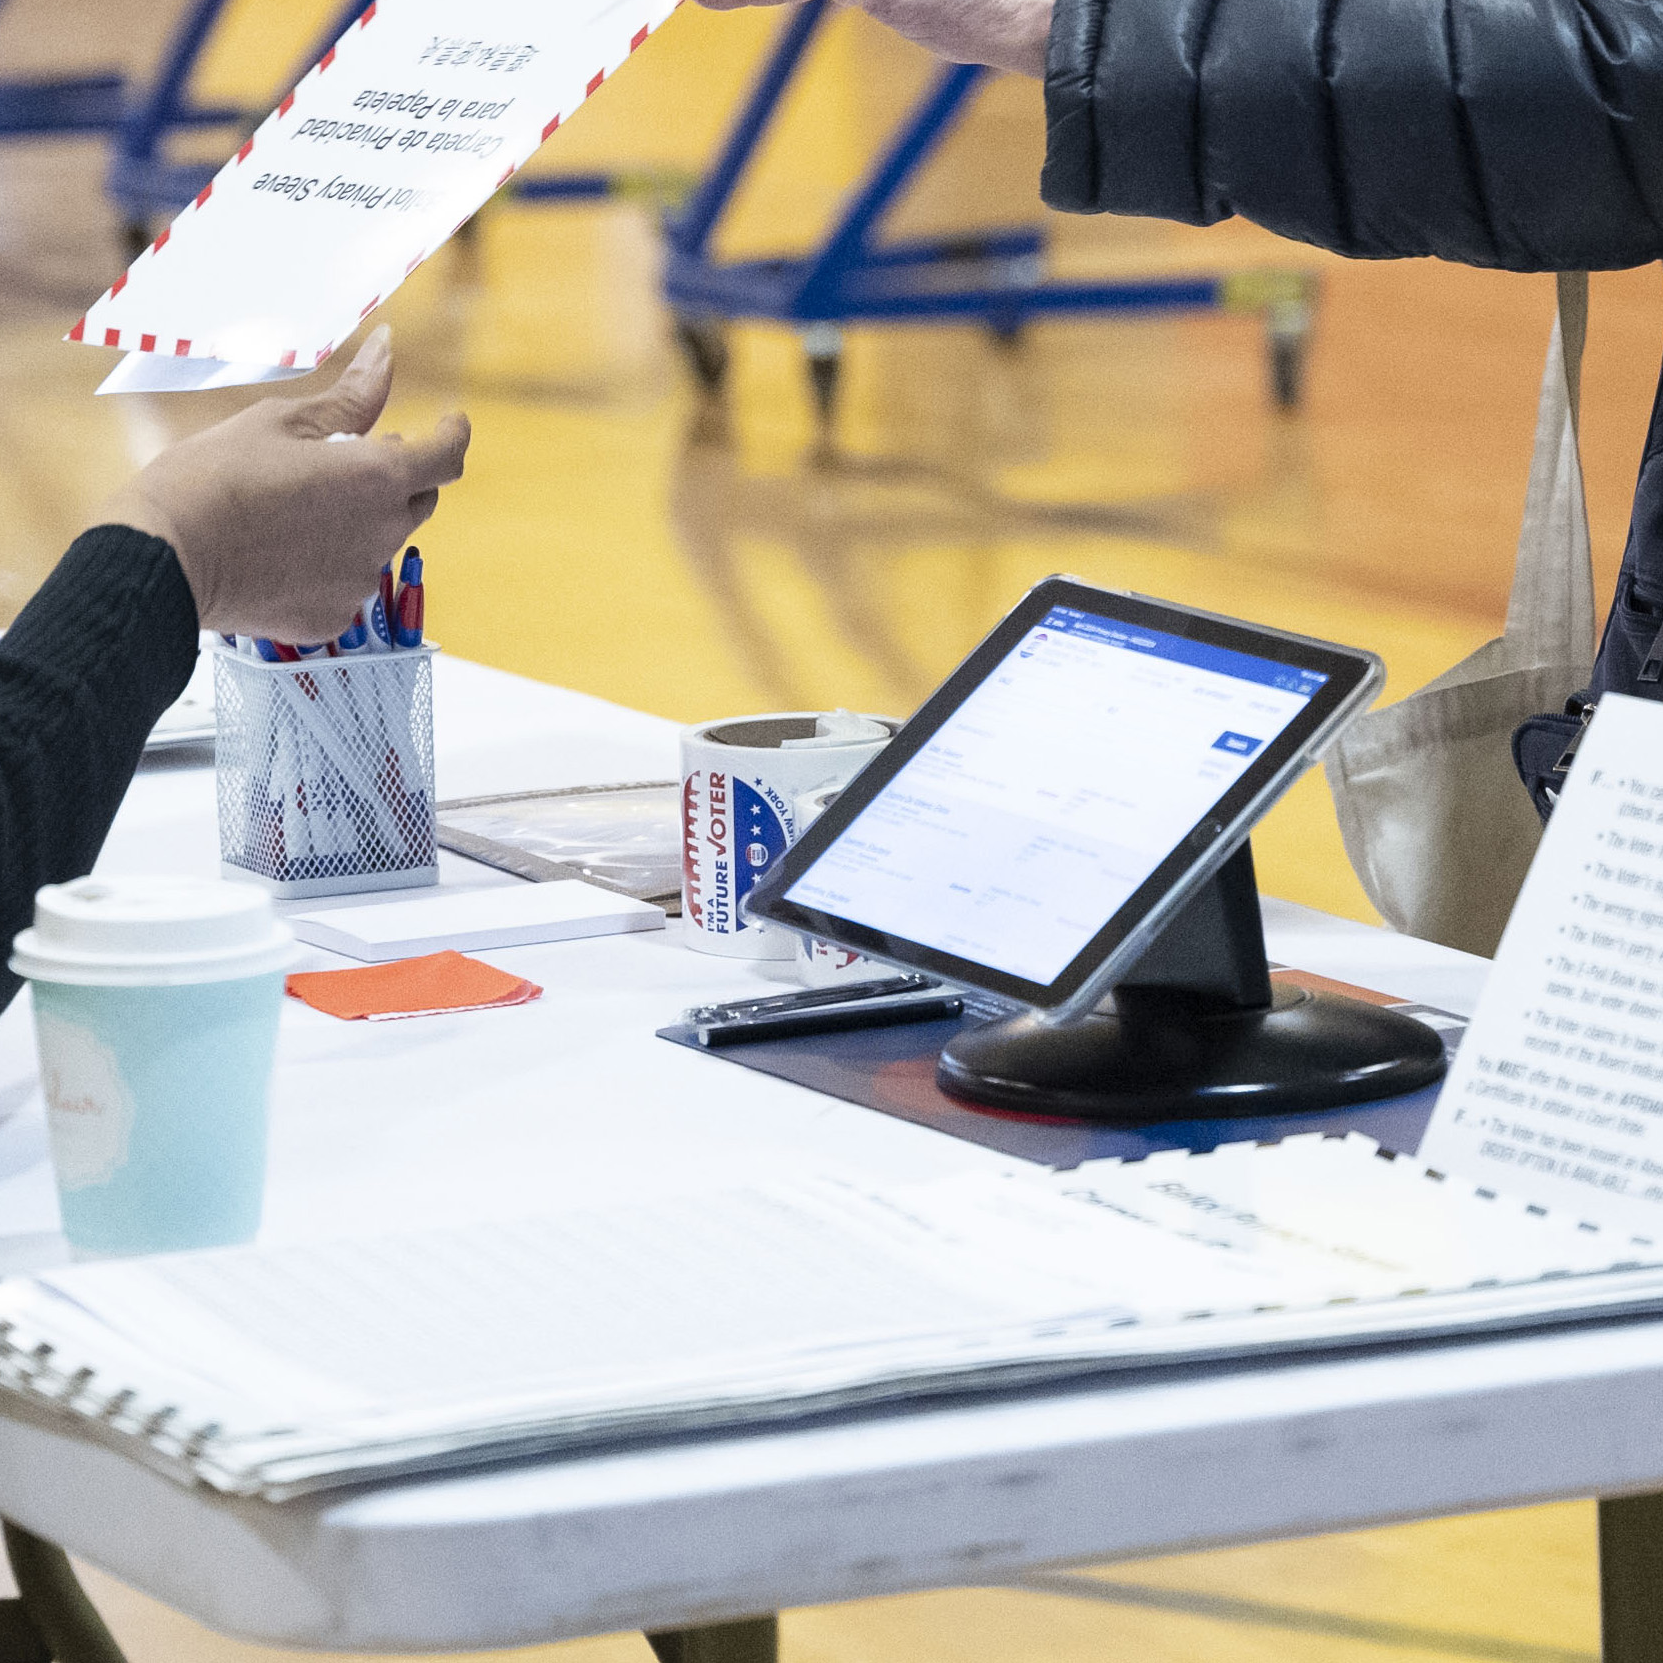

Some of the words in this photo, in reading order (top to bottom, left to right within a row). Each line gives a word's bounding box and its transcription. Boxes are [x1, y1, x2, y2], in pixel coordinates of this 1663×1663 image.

[352, 89, 440, 120] Papeleta
[441, 98, 461, 122] la
[457, 97, 515, 121] para
[291, 118, 402, 150] Privacidad
[396, 129, 428, 153] de
[428, 129, 504, 160] Carpeta
[251, 172, 319, 202] Sleeve
[316, 174, 387, 210] Privacy
[705, 771, 726, 856] VOTER
[765, 786, 789, 817] YORK
[706, 898, 714, 908] A
[714, 860, 730, 935] FUTURE
[706, 910, 715, 932] I'M
